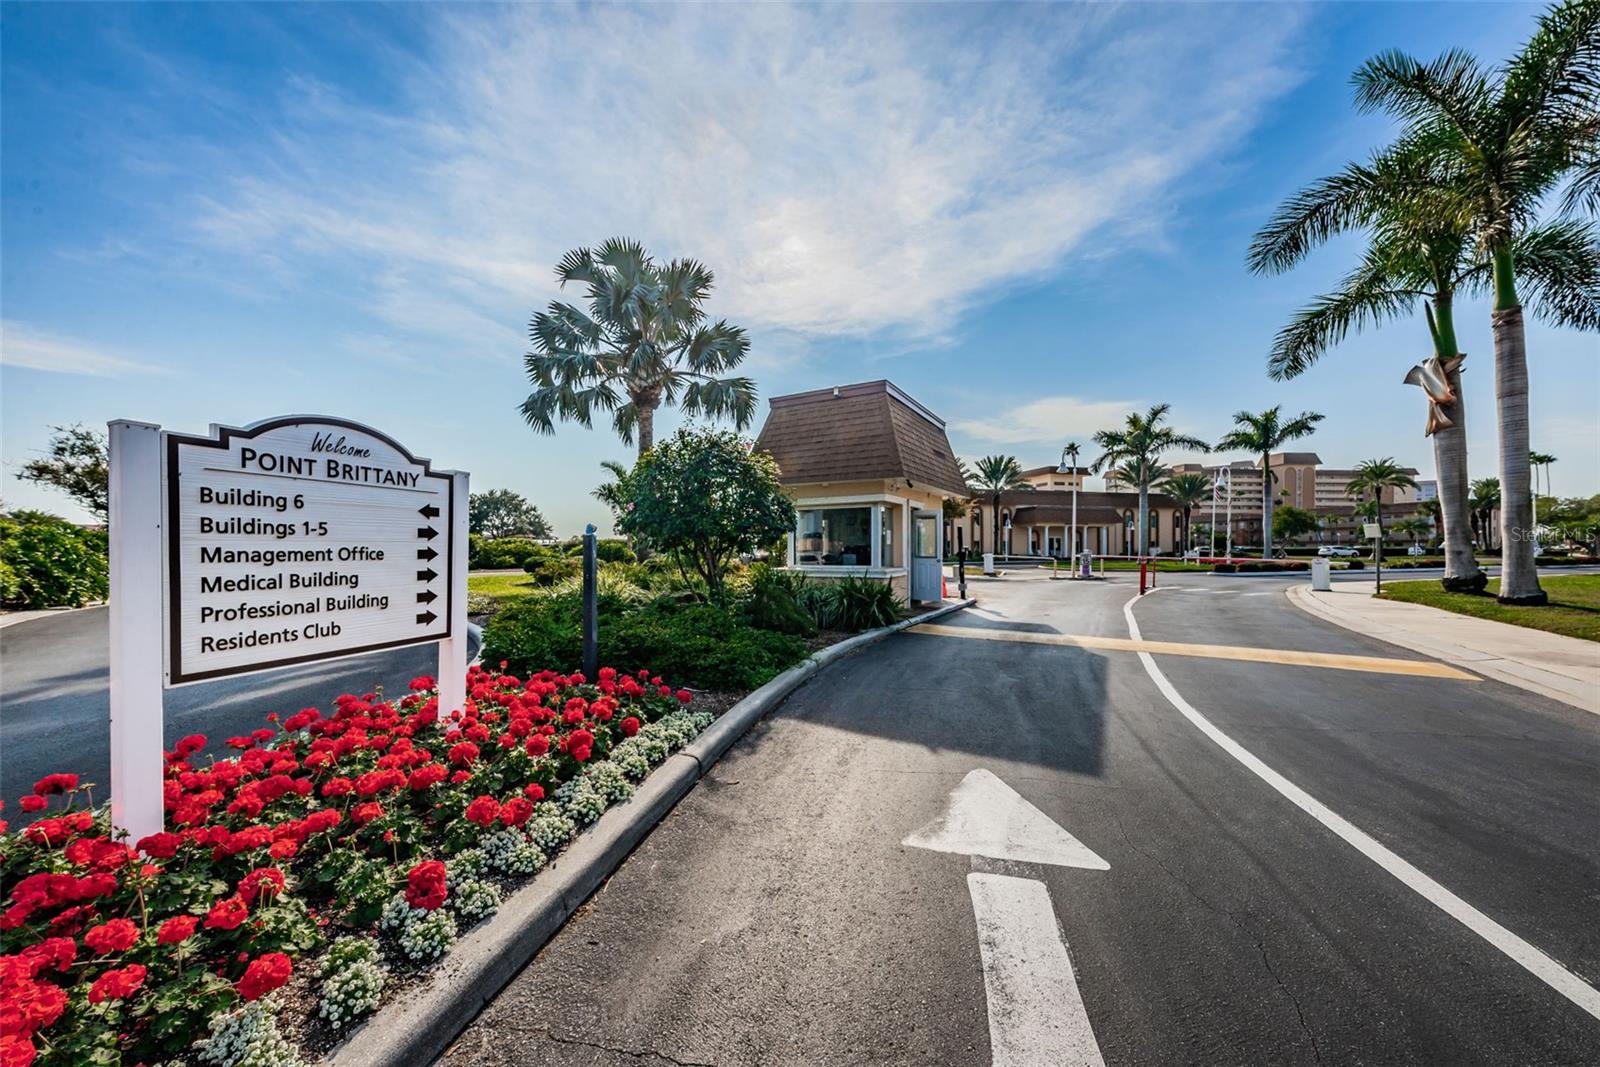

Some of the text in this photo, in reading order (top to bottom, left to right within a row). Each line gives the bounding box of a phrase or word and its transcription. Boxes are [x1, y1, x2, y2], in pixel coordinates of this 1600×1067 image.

[311, 432, 371, 458] Welcome
[241, 447, 420, 487] POINT BRITTANY
[200, 487, 304, 511] Building 6
[200, 517, 328, 538] Buildings 1-5
[200, 547, 385, 566] Management Office
[200, 572, 359, 593] Medical Building
[201, 595, 389, 623] Professional Building
[201, 621, 341, 653] Residents Club
